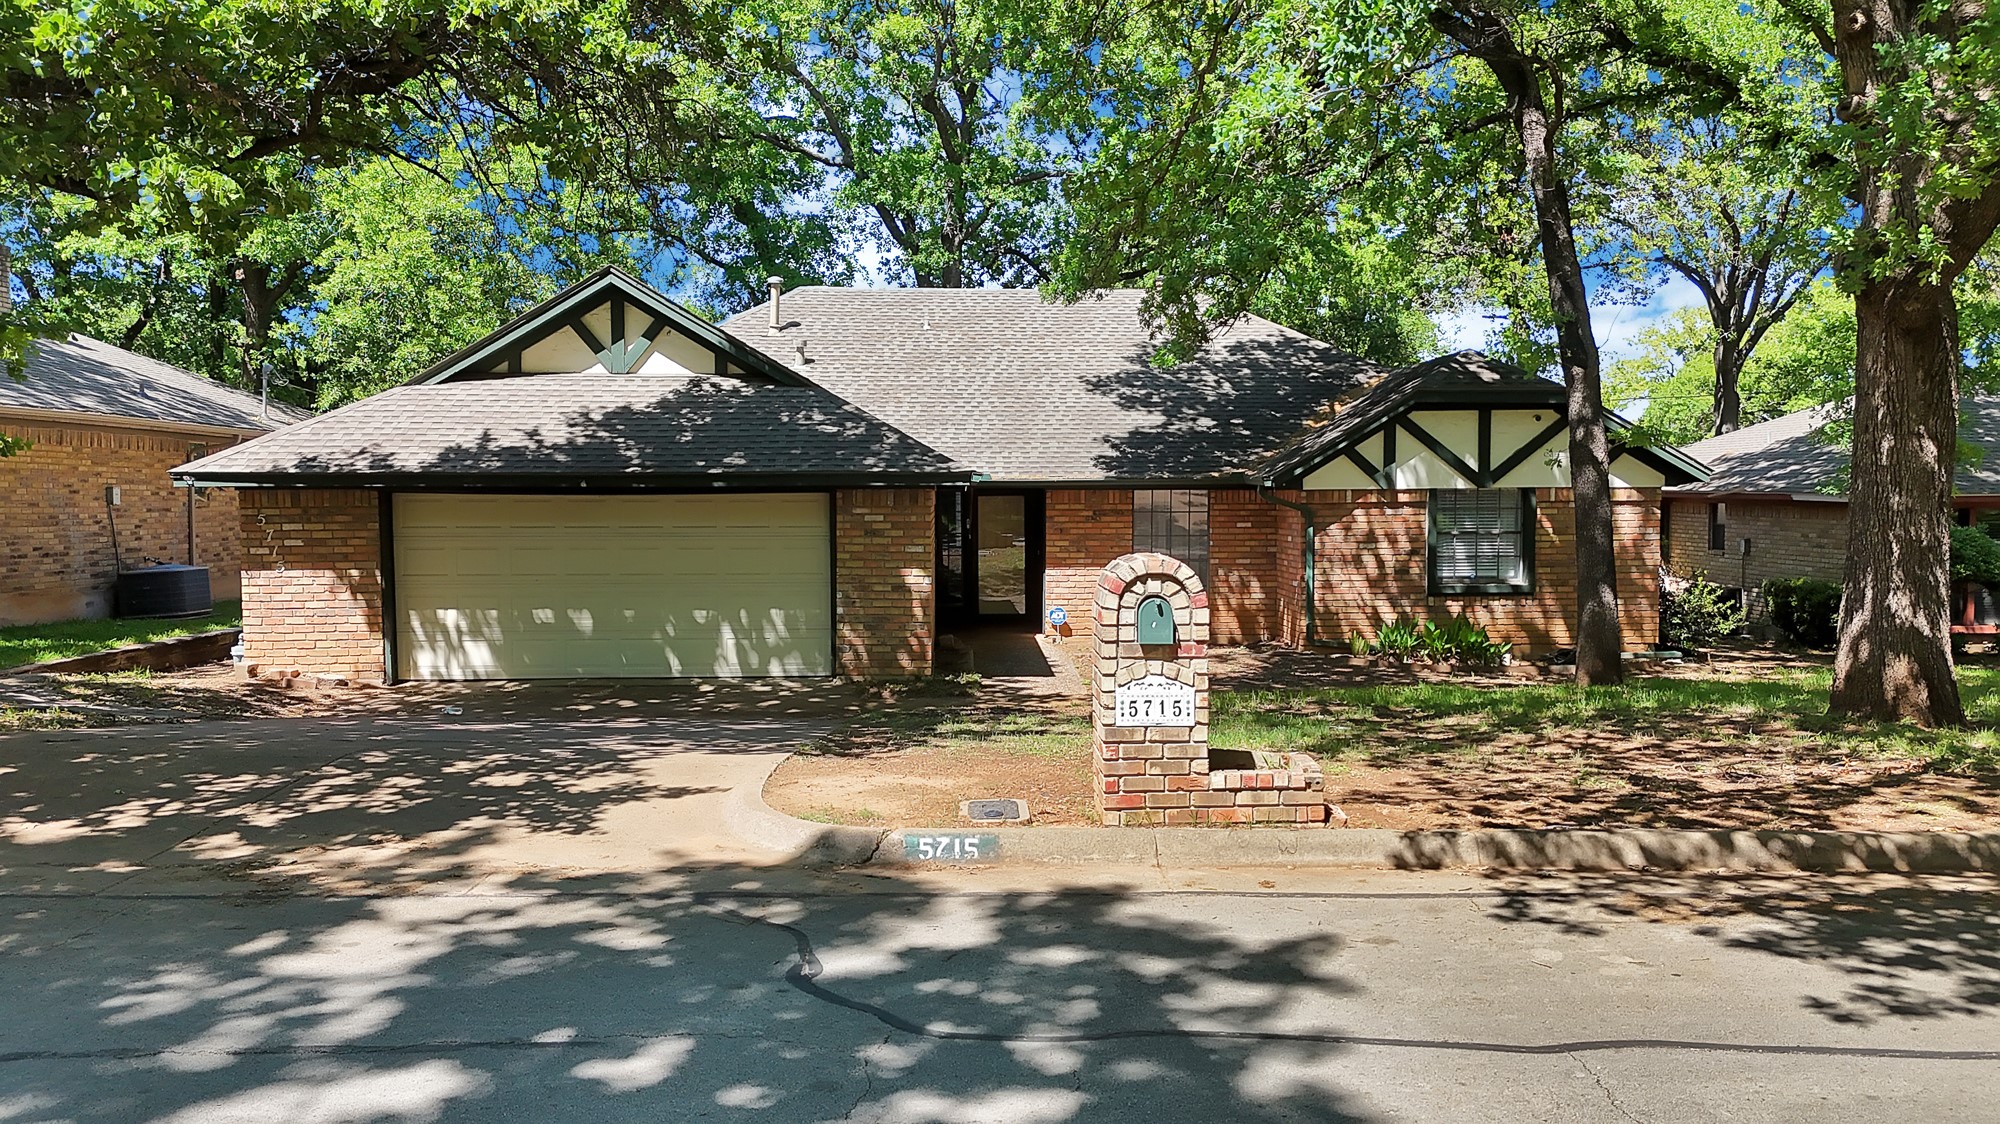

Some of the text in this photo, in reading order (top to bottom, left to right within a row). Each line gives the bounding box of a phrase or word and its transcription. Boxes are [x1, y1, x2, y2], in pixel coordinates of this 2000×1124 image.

[256, 513, 285, 573] 5715
[1128, 699, 1182, 717] 5715
[918, 837, 979, 859] 5715
